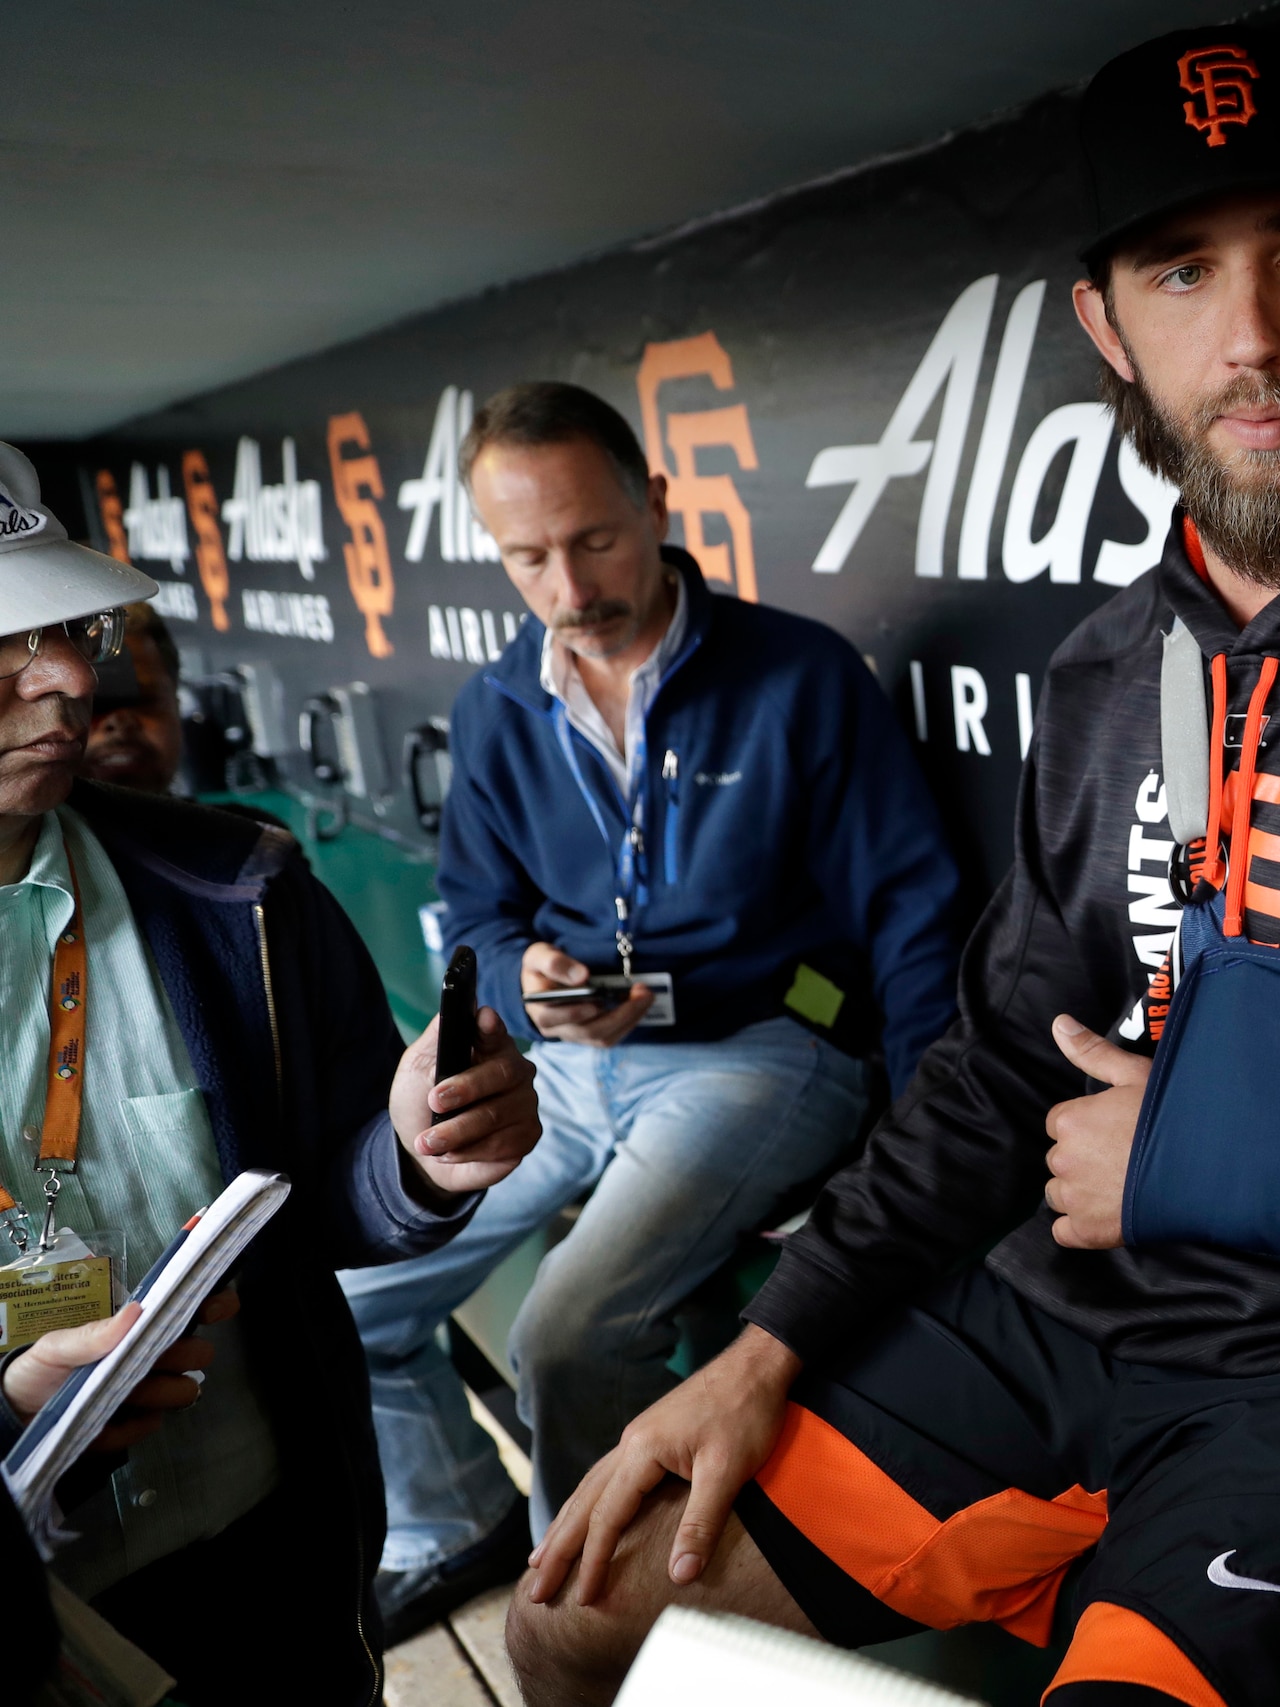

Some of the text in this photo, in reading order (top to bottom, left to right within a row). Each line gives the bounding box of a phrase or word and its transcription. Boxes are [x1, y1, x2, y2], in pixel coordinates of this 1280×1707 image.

[1177, 45, 1260, 147] SF
[428, 604, 529, 665] AIRLI
[0, 1286, 43, 1300] ssociation
